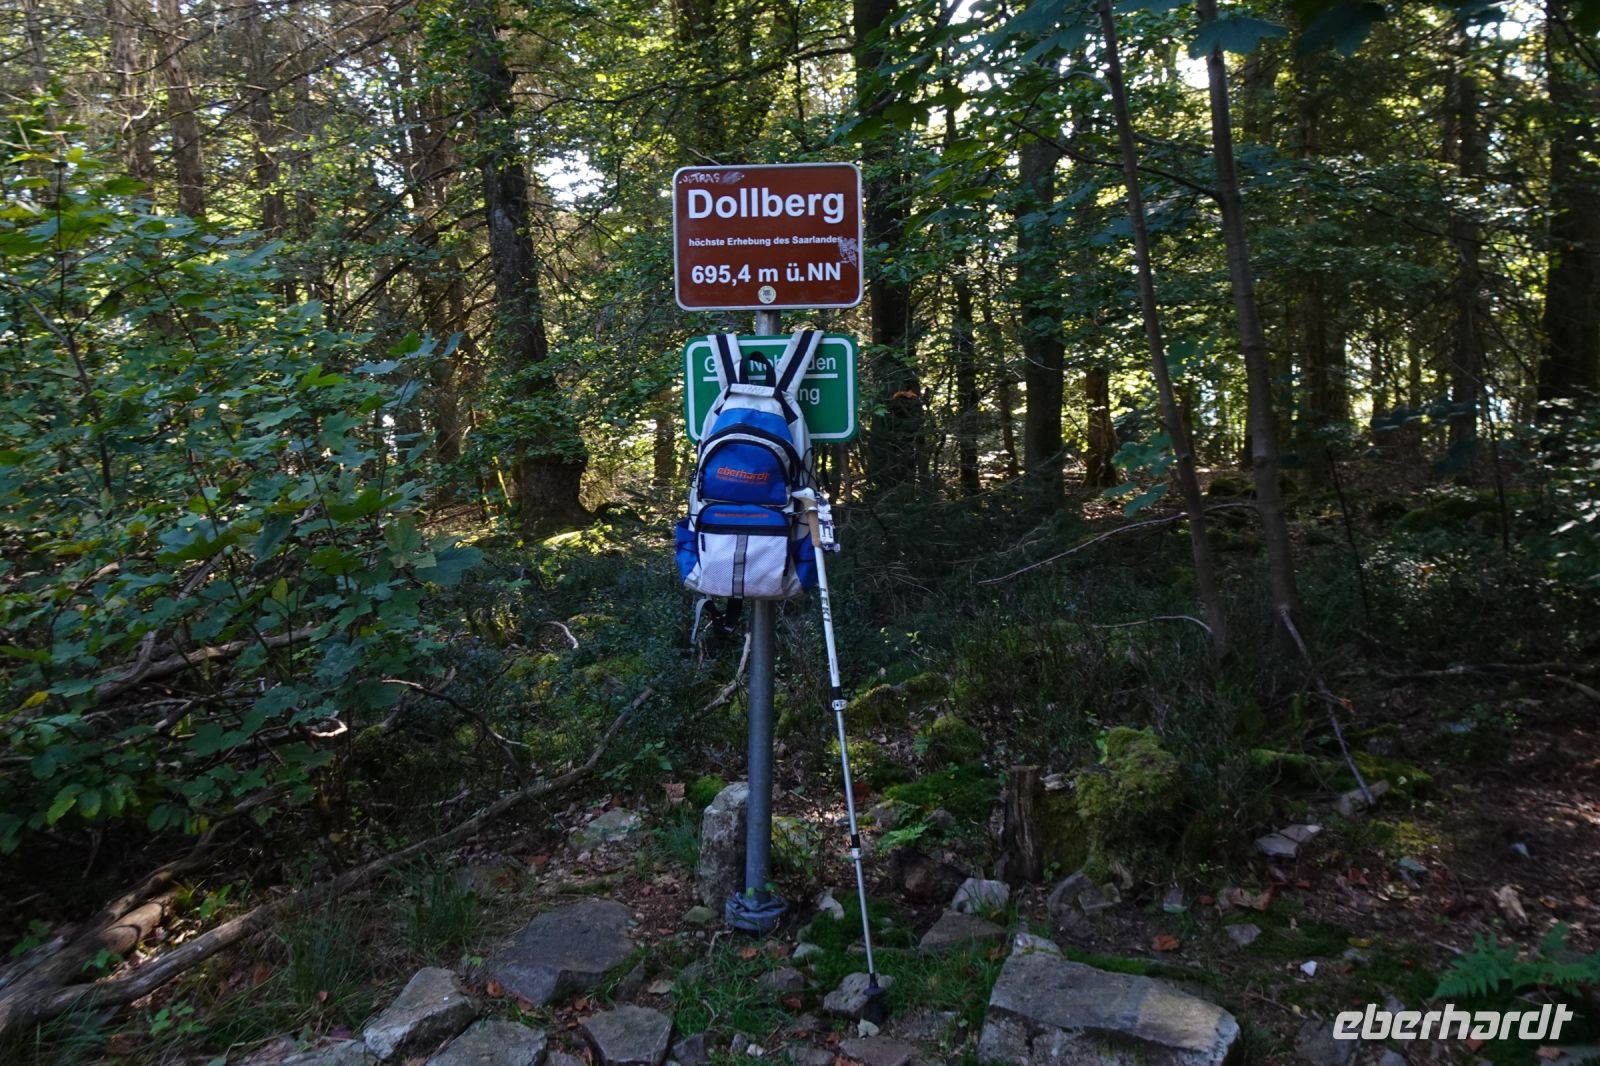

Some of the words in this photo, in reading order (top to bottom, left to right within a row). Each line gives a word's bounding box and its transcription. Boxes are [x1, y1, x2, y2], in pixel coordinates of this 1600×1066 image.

[687, 187, 844, 224] Dollberg
[688, 237, 725, 247] höchste
[727, 237, 771, 247] Erhebung
[791, 236, 842, 244] Saarlandes
[691, 264, 751, 286] 695,4
[758, 268, 778, 283] m
[786, 262, 841, 282] ü.NN
